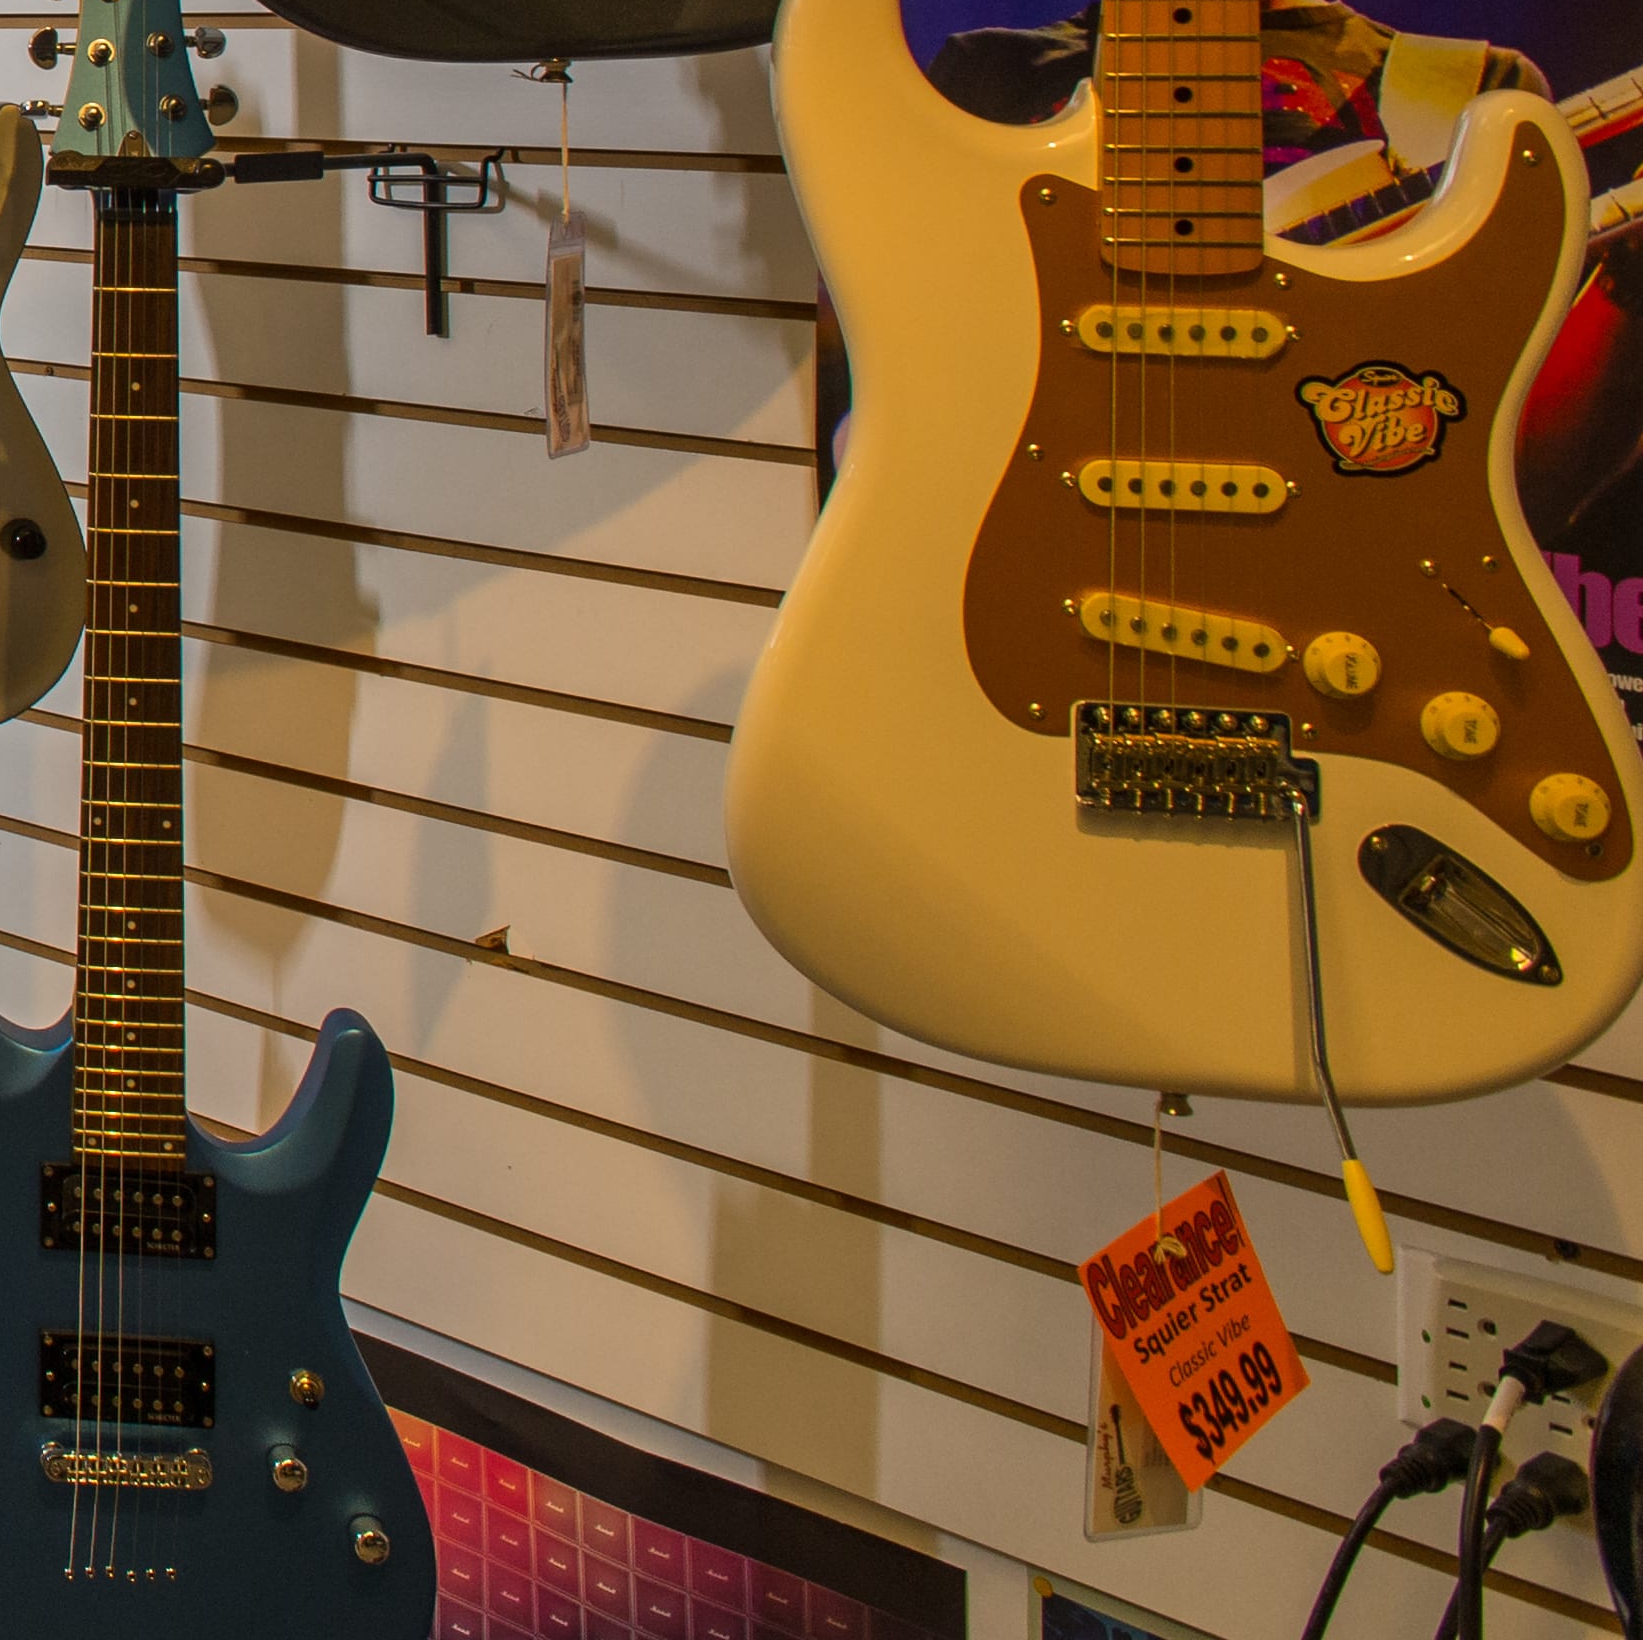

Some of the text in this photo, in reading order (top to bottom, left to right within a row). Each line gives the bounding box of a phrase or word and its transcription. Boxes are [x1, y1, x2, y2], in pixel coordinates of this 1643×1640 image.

[1300, 376, 1459, 424] Classic
[1339, 413, 1427, 458] Vibe
[1086, 1175, 1246, 1341] Clearance!
[1133, 1270, 1254, 1365] Squier Strat
[1168, 1311, 1253, 1390] Classic Vibe
[1178, 1340, 1284, 1463] $349.99
[1101, 1421, 1114, 1491] Murphy's
[1113, 1465, 1144, 1526] GUITARS
